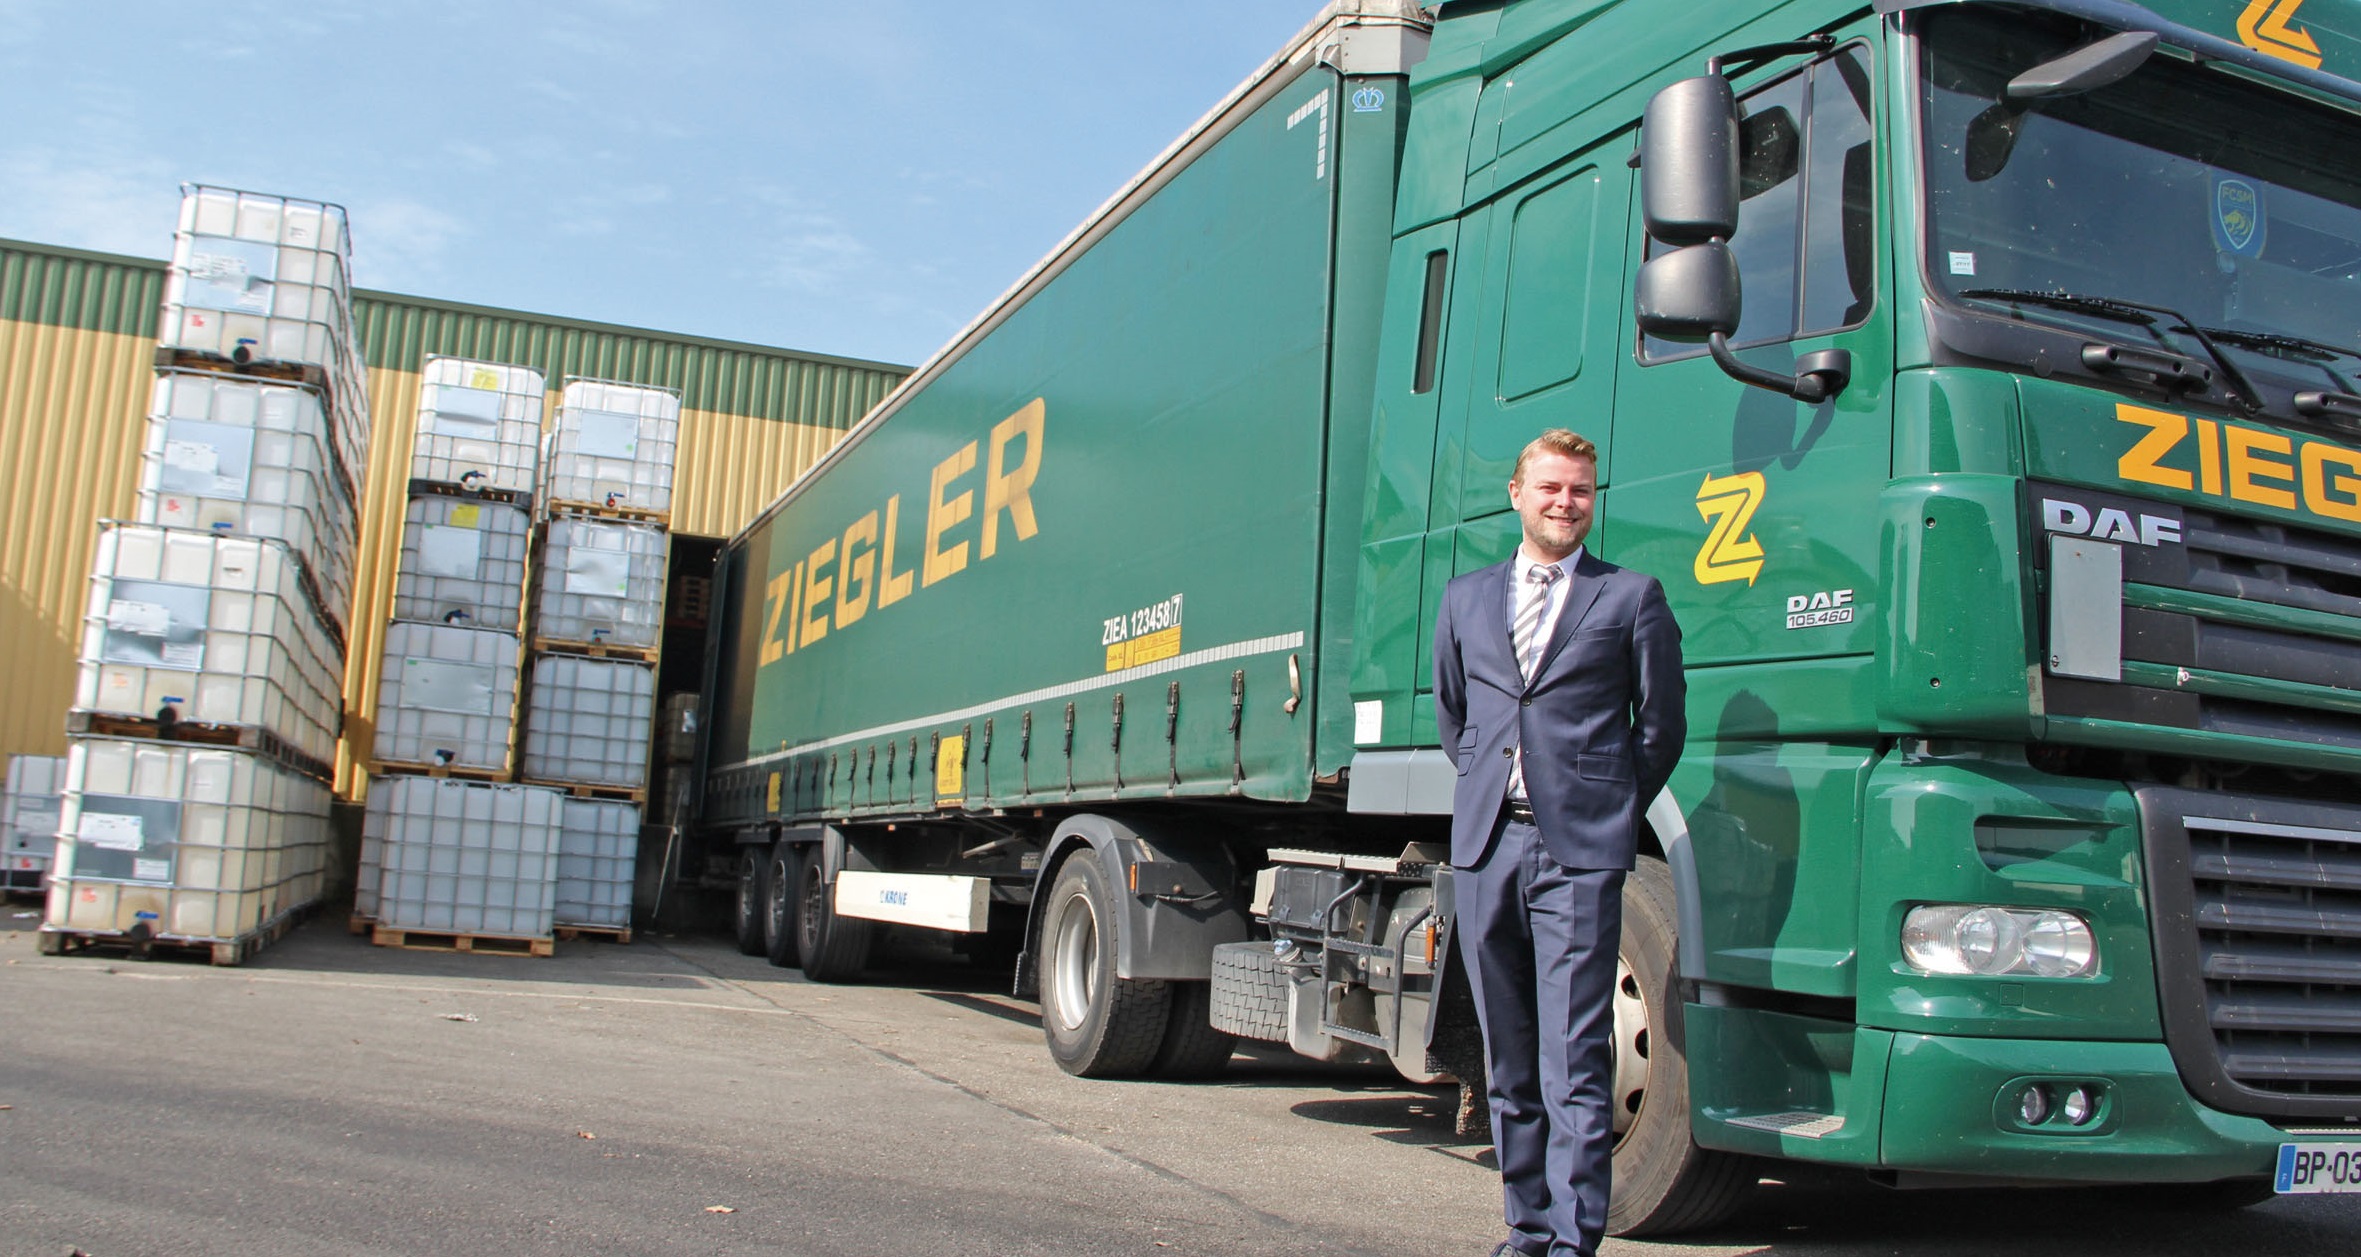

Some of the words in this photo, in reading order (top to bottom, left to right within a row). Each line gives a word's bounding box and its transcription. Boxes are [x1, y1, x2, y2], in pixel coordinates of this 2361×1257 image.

[2115, 402, 2361, 522] ZIEG
[760, 397, 1046, 668] ZIEGLER
[2042, 498, 2181, 547] DAF
[1787, 589, 1853, 613] DAF
[1788, 609, 1850, 627] 105.460
[1102, 614, 1128, 646] ZIEA
